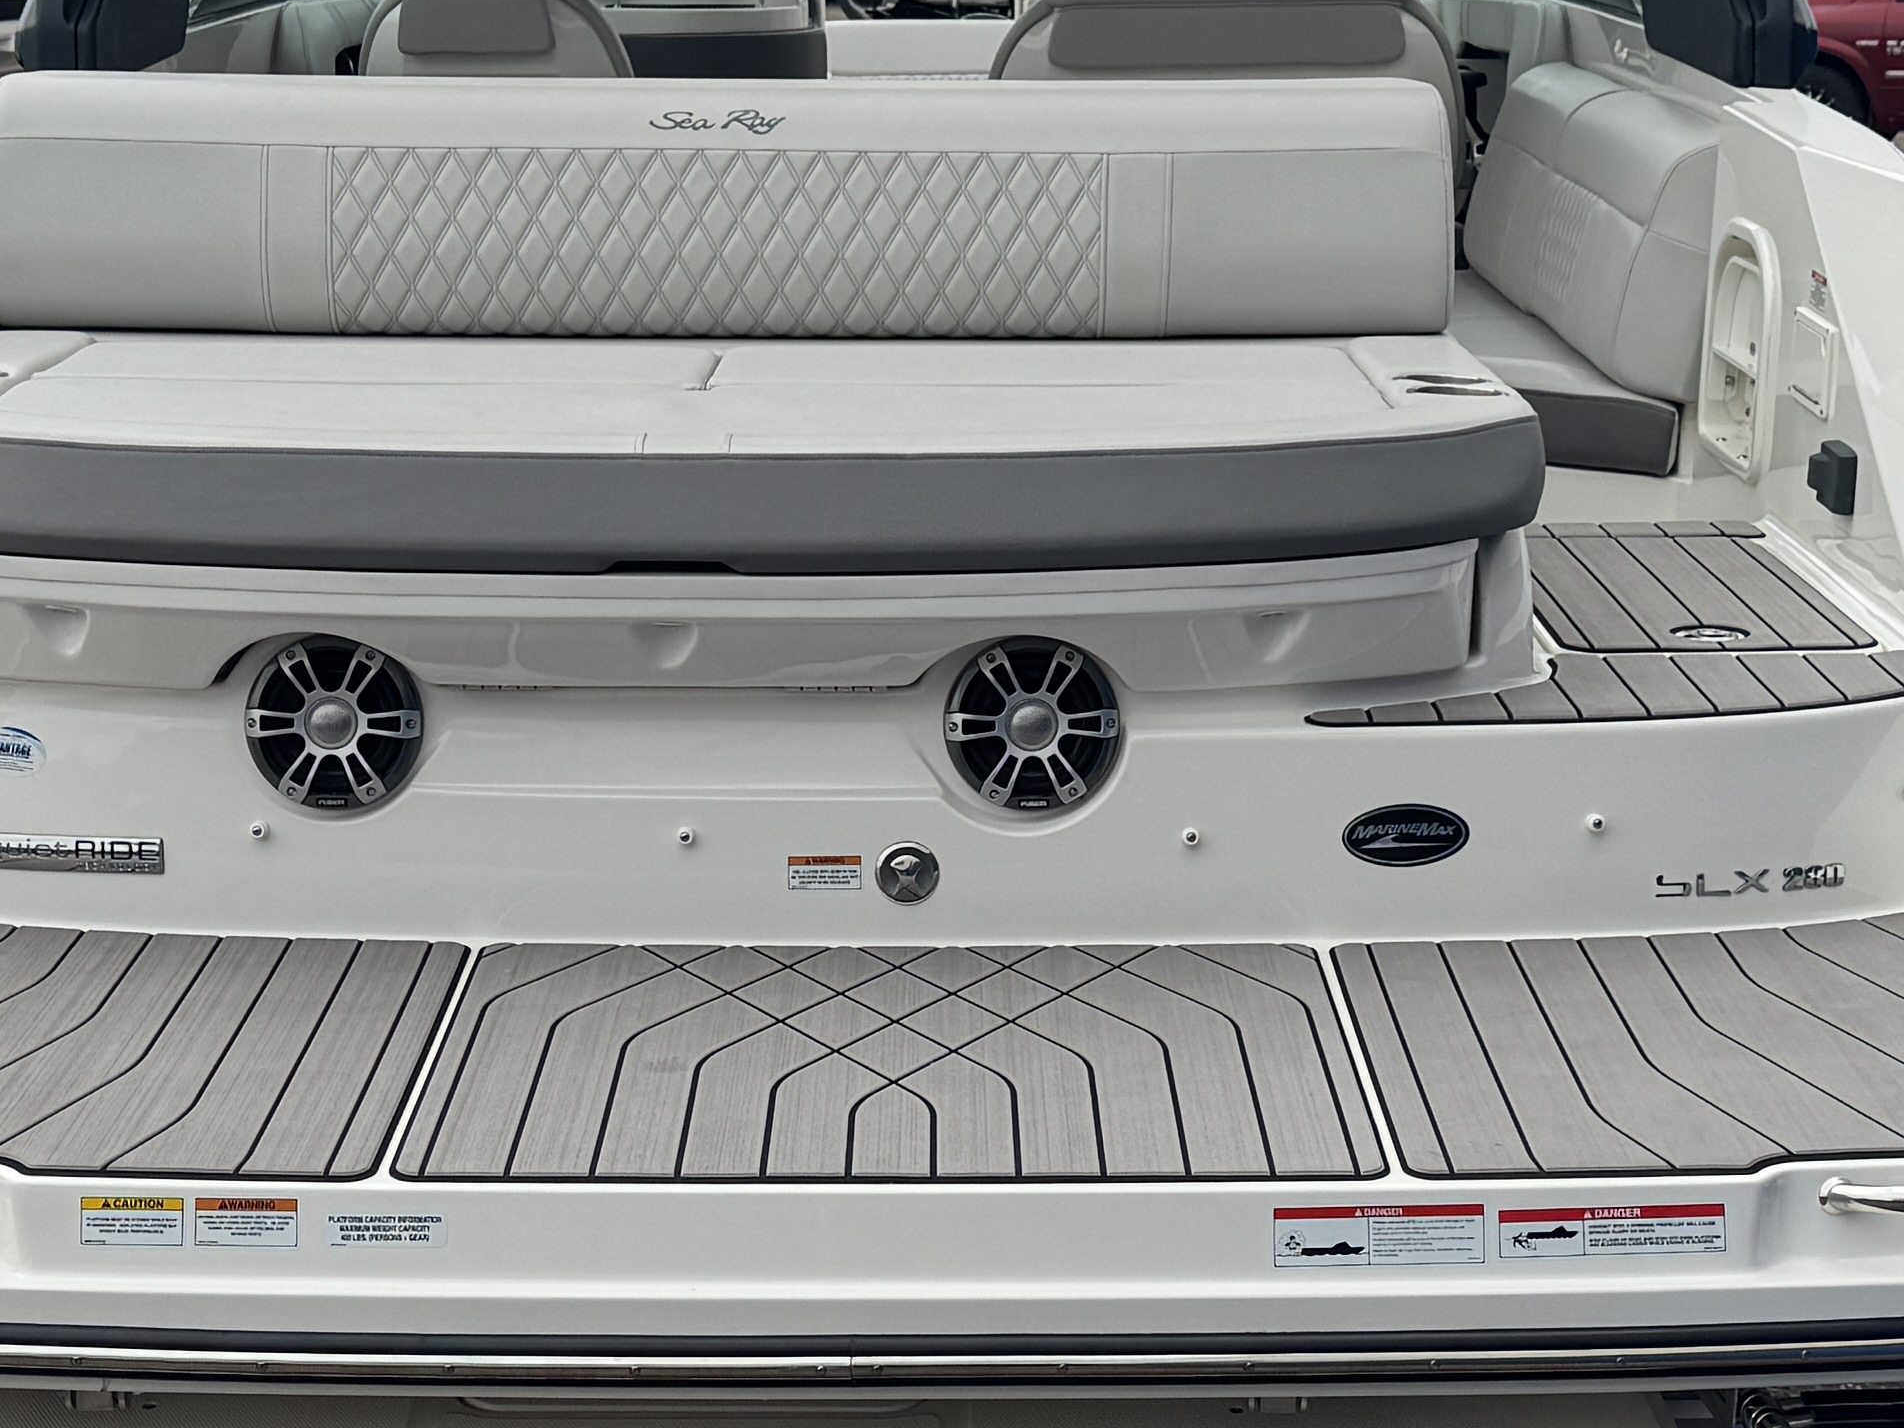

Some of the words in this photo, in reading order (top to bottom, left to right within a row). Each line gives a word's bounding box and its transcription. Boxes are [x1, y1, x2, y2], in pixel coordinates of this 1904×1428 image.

[649, 111, 716, 131] Sea
[720, 109, 786, 135] Ray
[1655, 868, 1770, 897] SLX
[113, 1199, 164, 1209] CAUTION
[228, 1200, 276, 1210] WARNING
[1364, 1208, 1403, 1217] DANGER
[1594, 1208, 1641, 1219] DANGER
